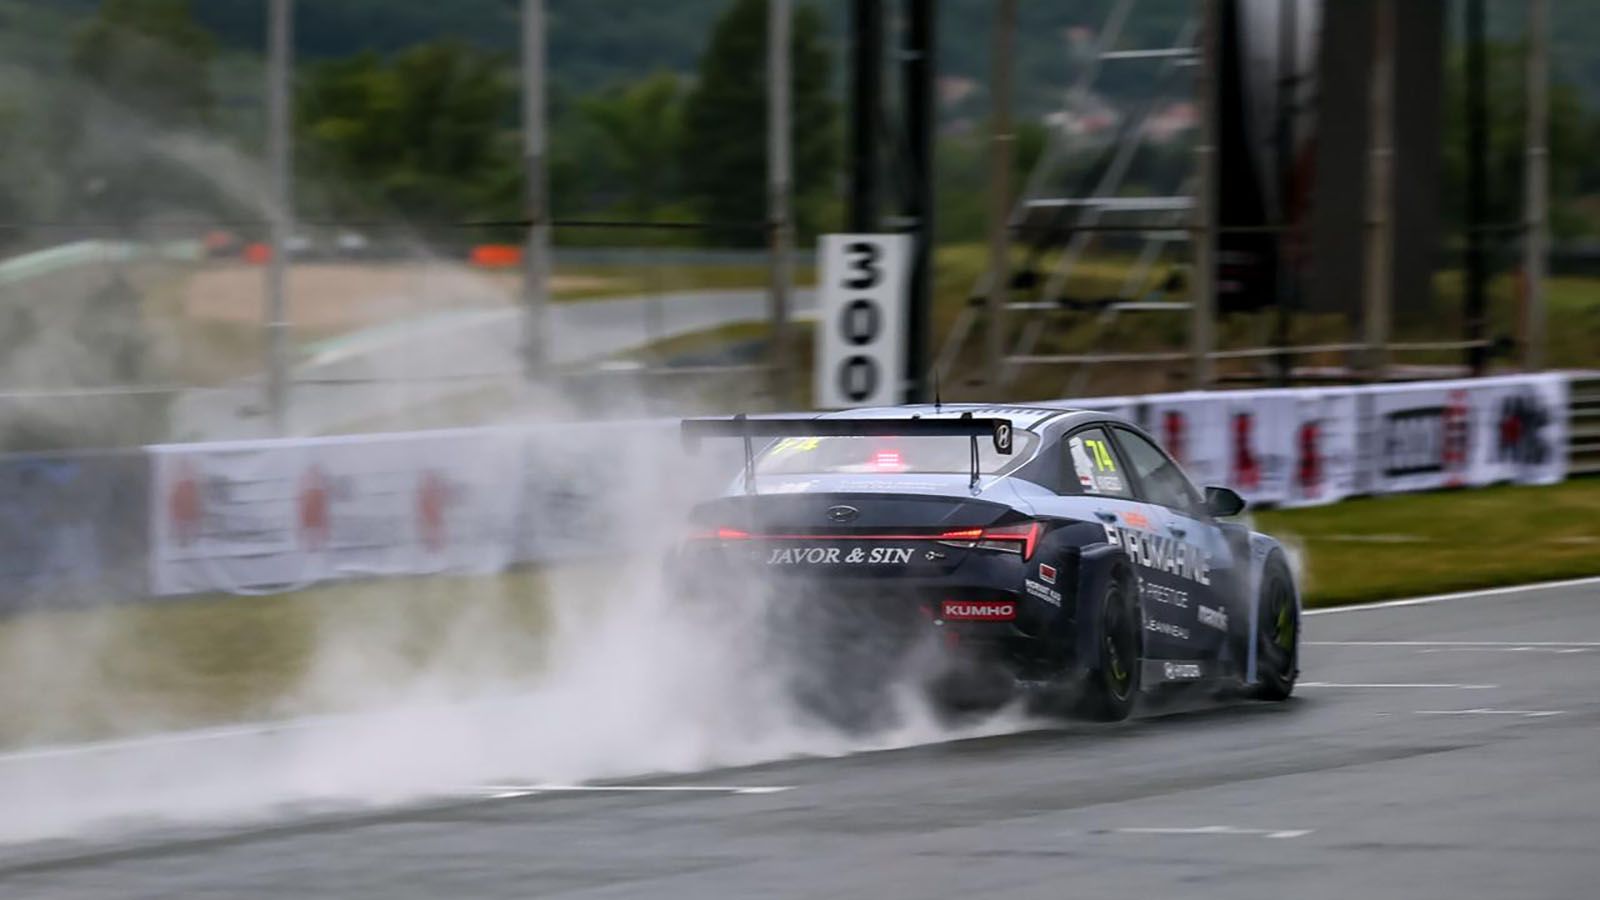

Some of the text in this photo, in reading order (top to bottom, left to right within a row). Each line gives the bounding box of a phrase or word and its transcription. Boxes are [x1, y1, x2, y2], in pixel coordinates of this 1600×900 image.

[838, 242, 885, 402] 300
[1083, 439, 1117, 472] 74
[767, 547, 842, 565] JAVOR
[845, 547, 866, 564] &
[868, 547, 915, 564] SIN
[1146, 582, 1189, 608] PRESTIGE
[945, 604, 1013, 616] KUMHO
